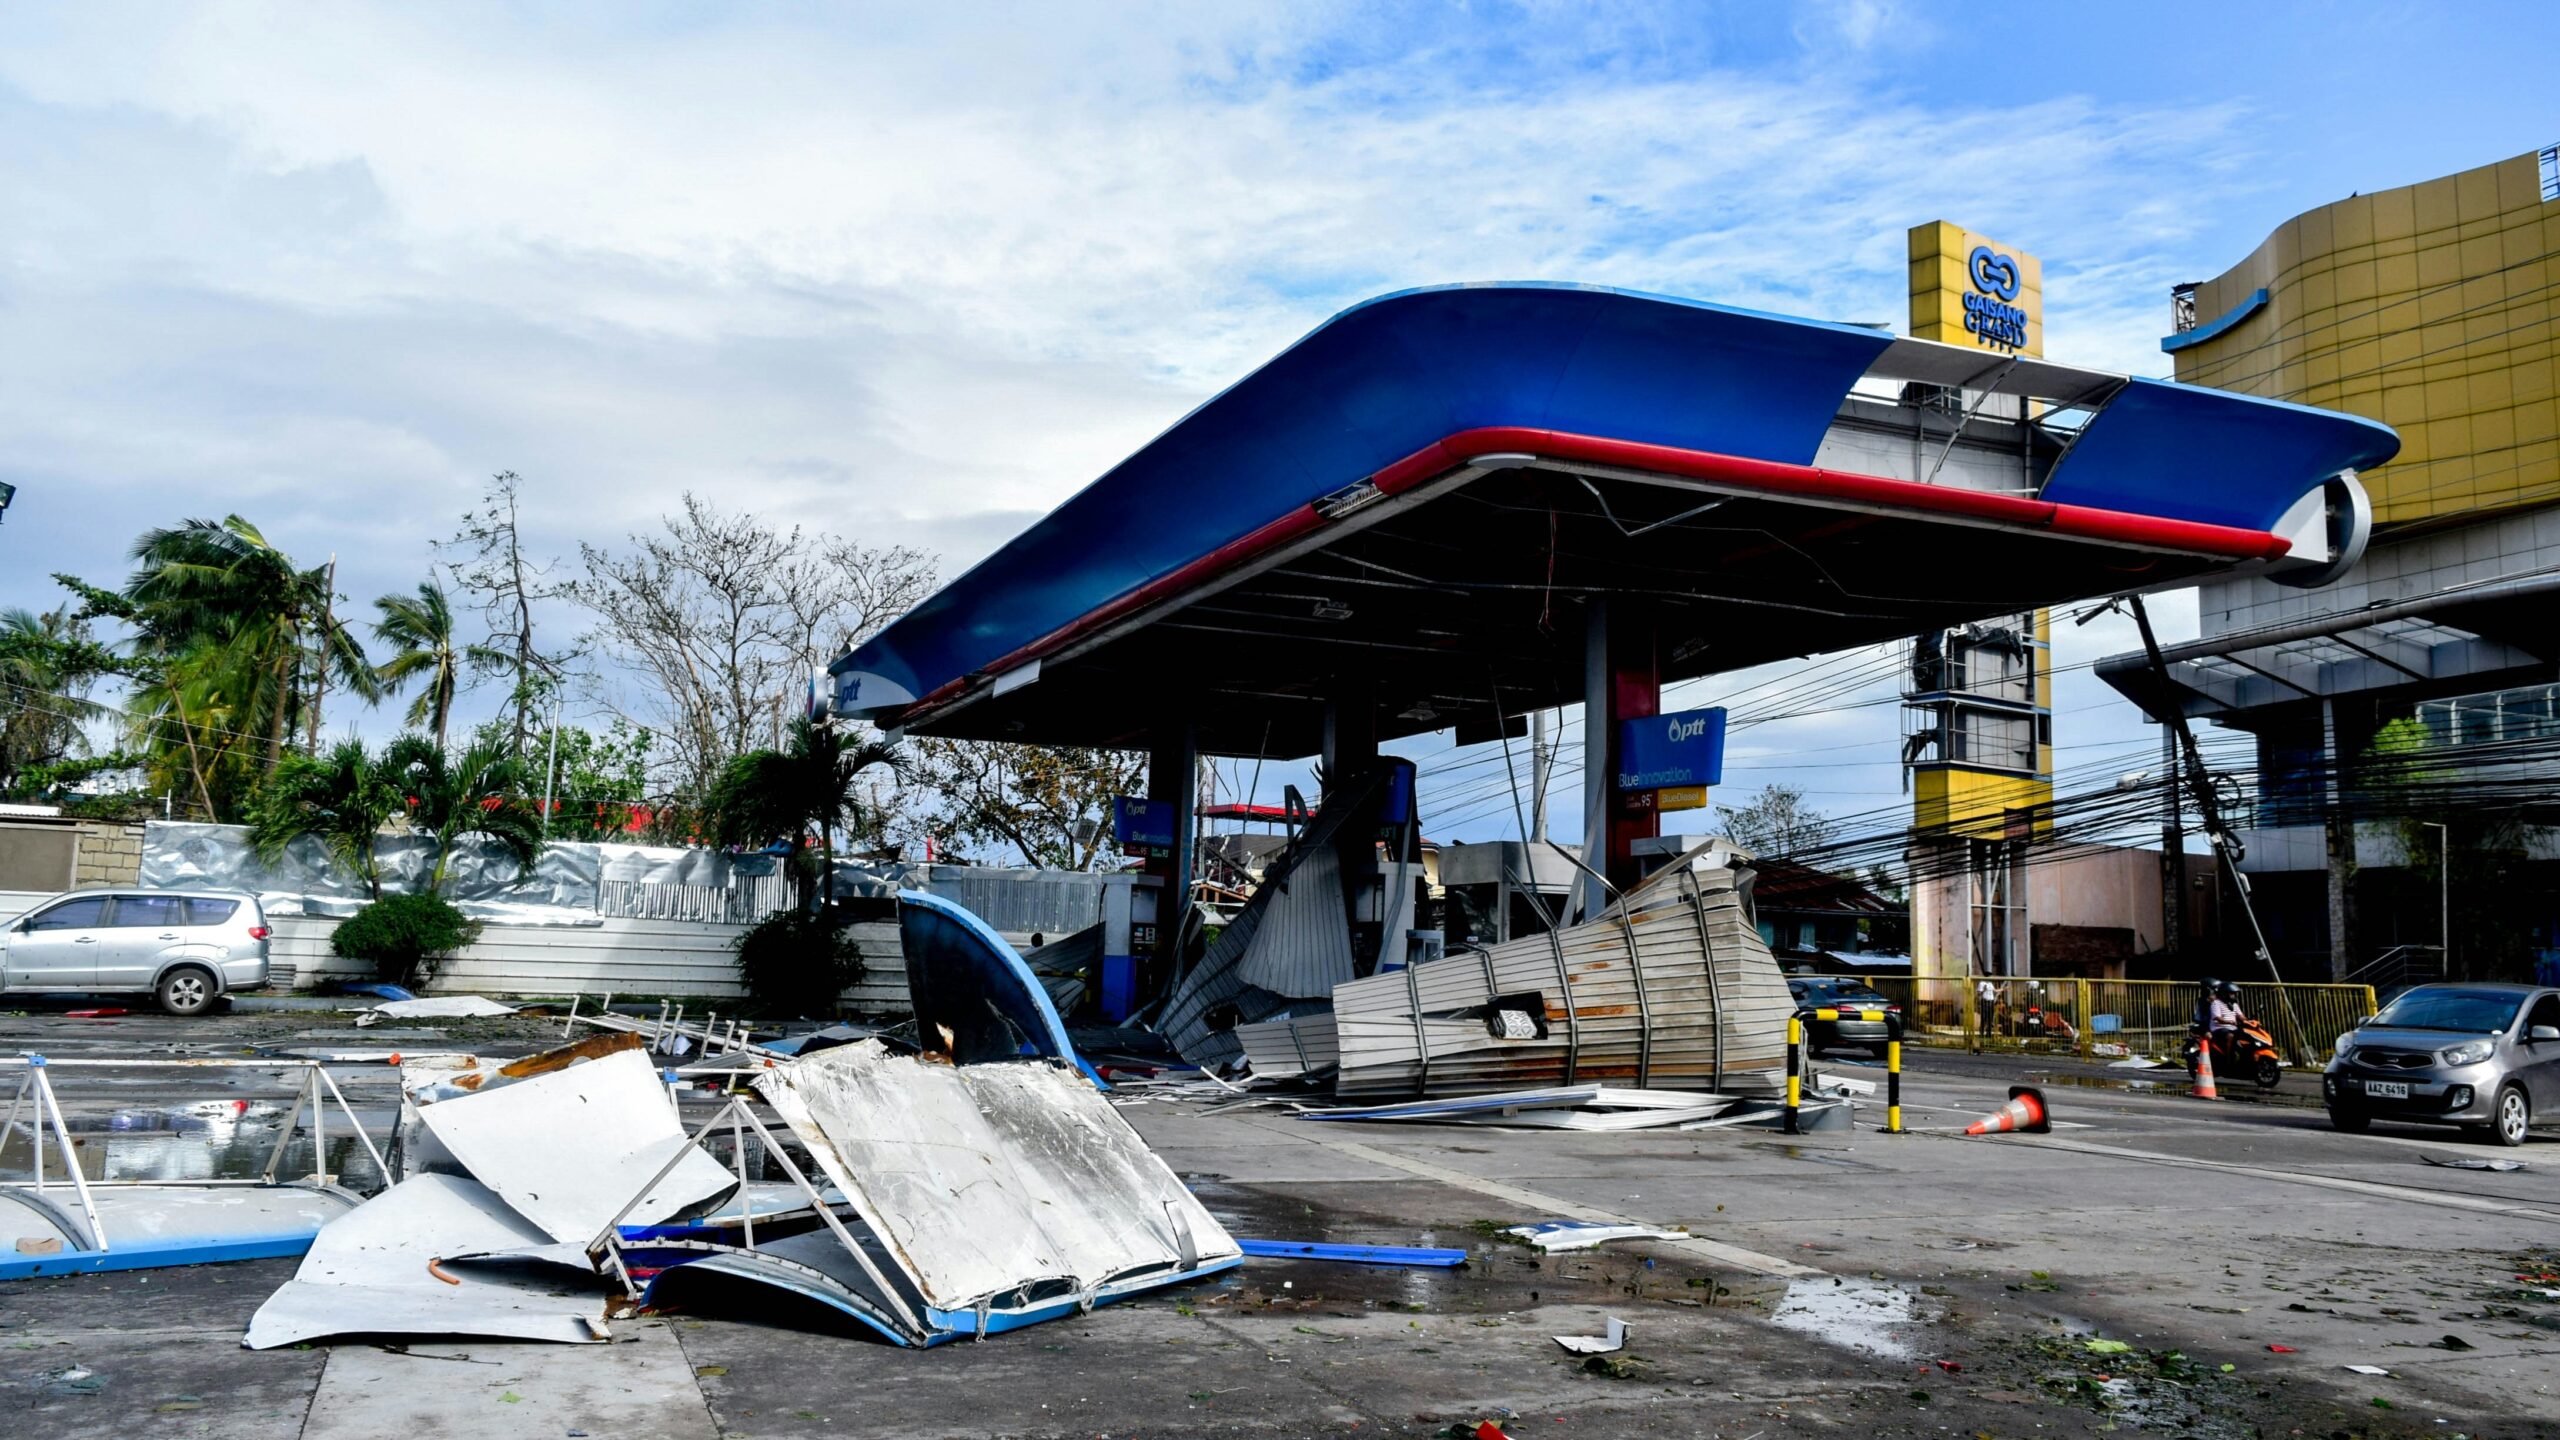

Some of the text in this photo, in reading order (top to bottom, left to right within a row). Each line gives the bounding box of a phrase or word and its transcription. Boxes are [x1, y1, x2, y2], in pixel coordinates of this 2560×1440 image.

[1962, 291, 2027, 330] GAISANO
[1964, 311, 2027, 349] GRAND
[841, 678, 861, 710] ptt
[1681, 719, 1706, 741] ptt
